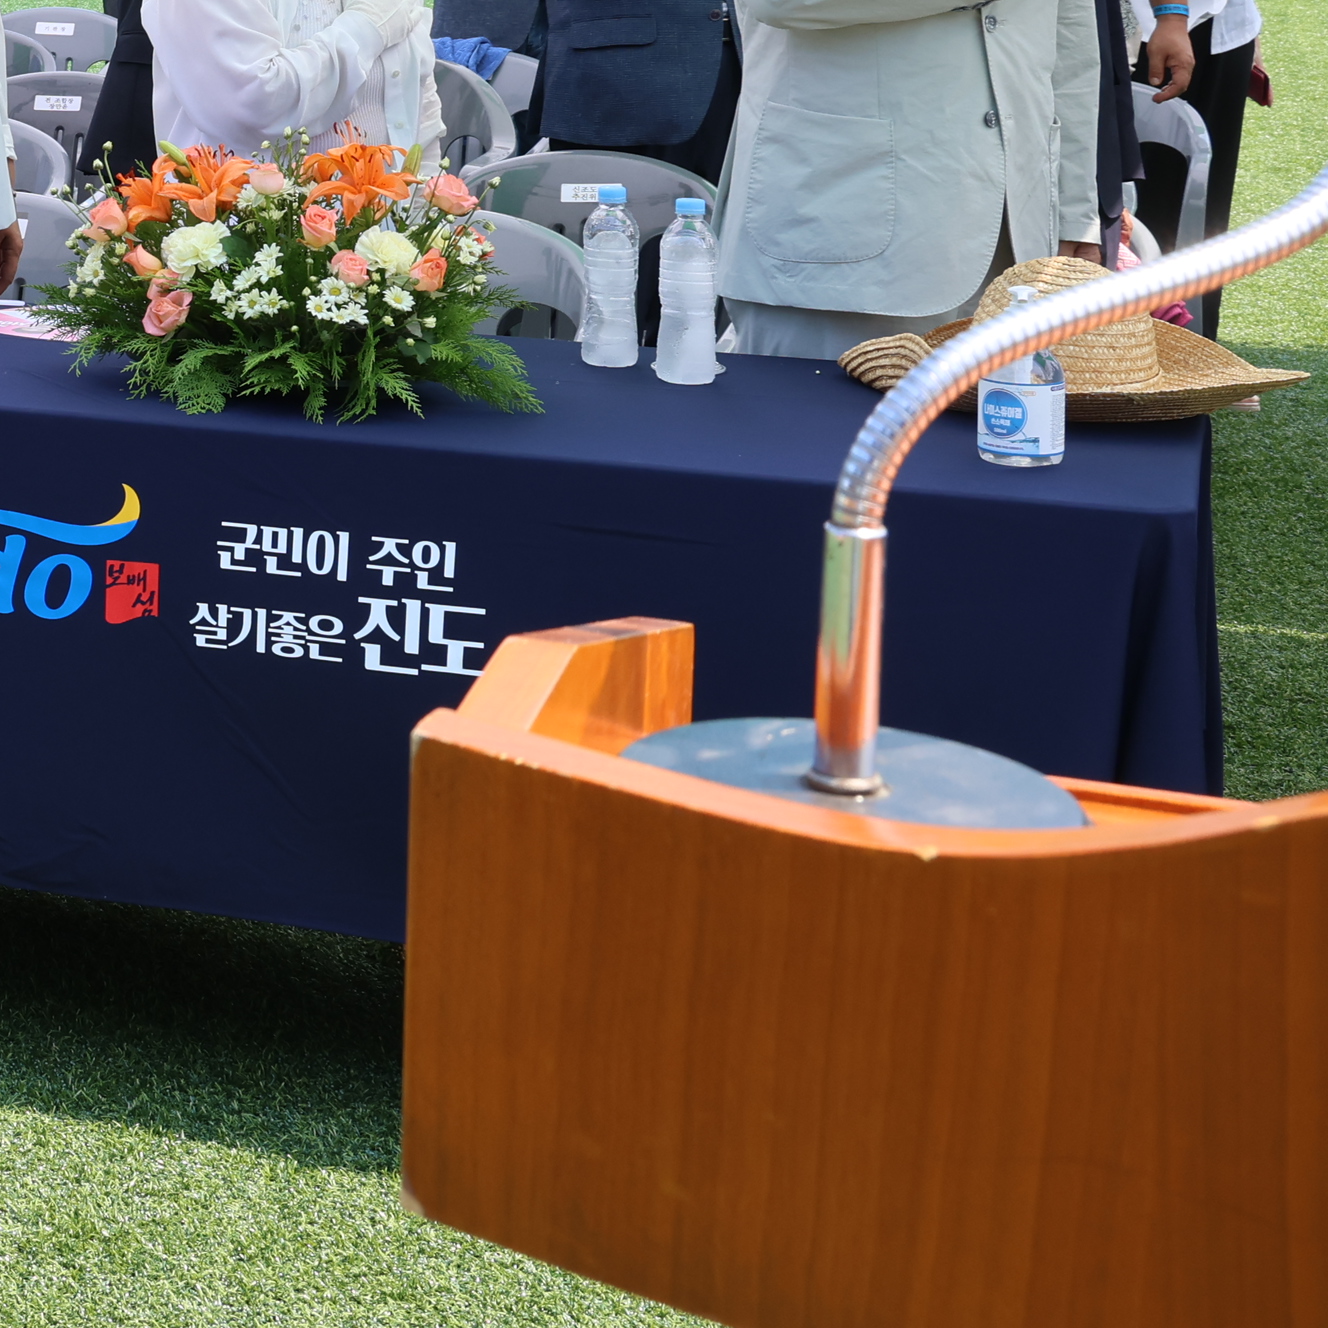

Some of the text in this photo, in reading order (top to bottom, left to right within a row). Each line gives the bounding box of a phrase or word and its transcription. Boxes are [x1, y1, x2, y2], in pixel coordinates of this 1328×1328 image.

[217, 520, 457, 593] 군민이 주인
[189, 596, 487, 676] 살기좋은 진도
